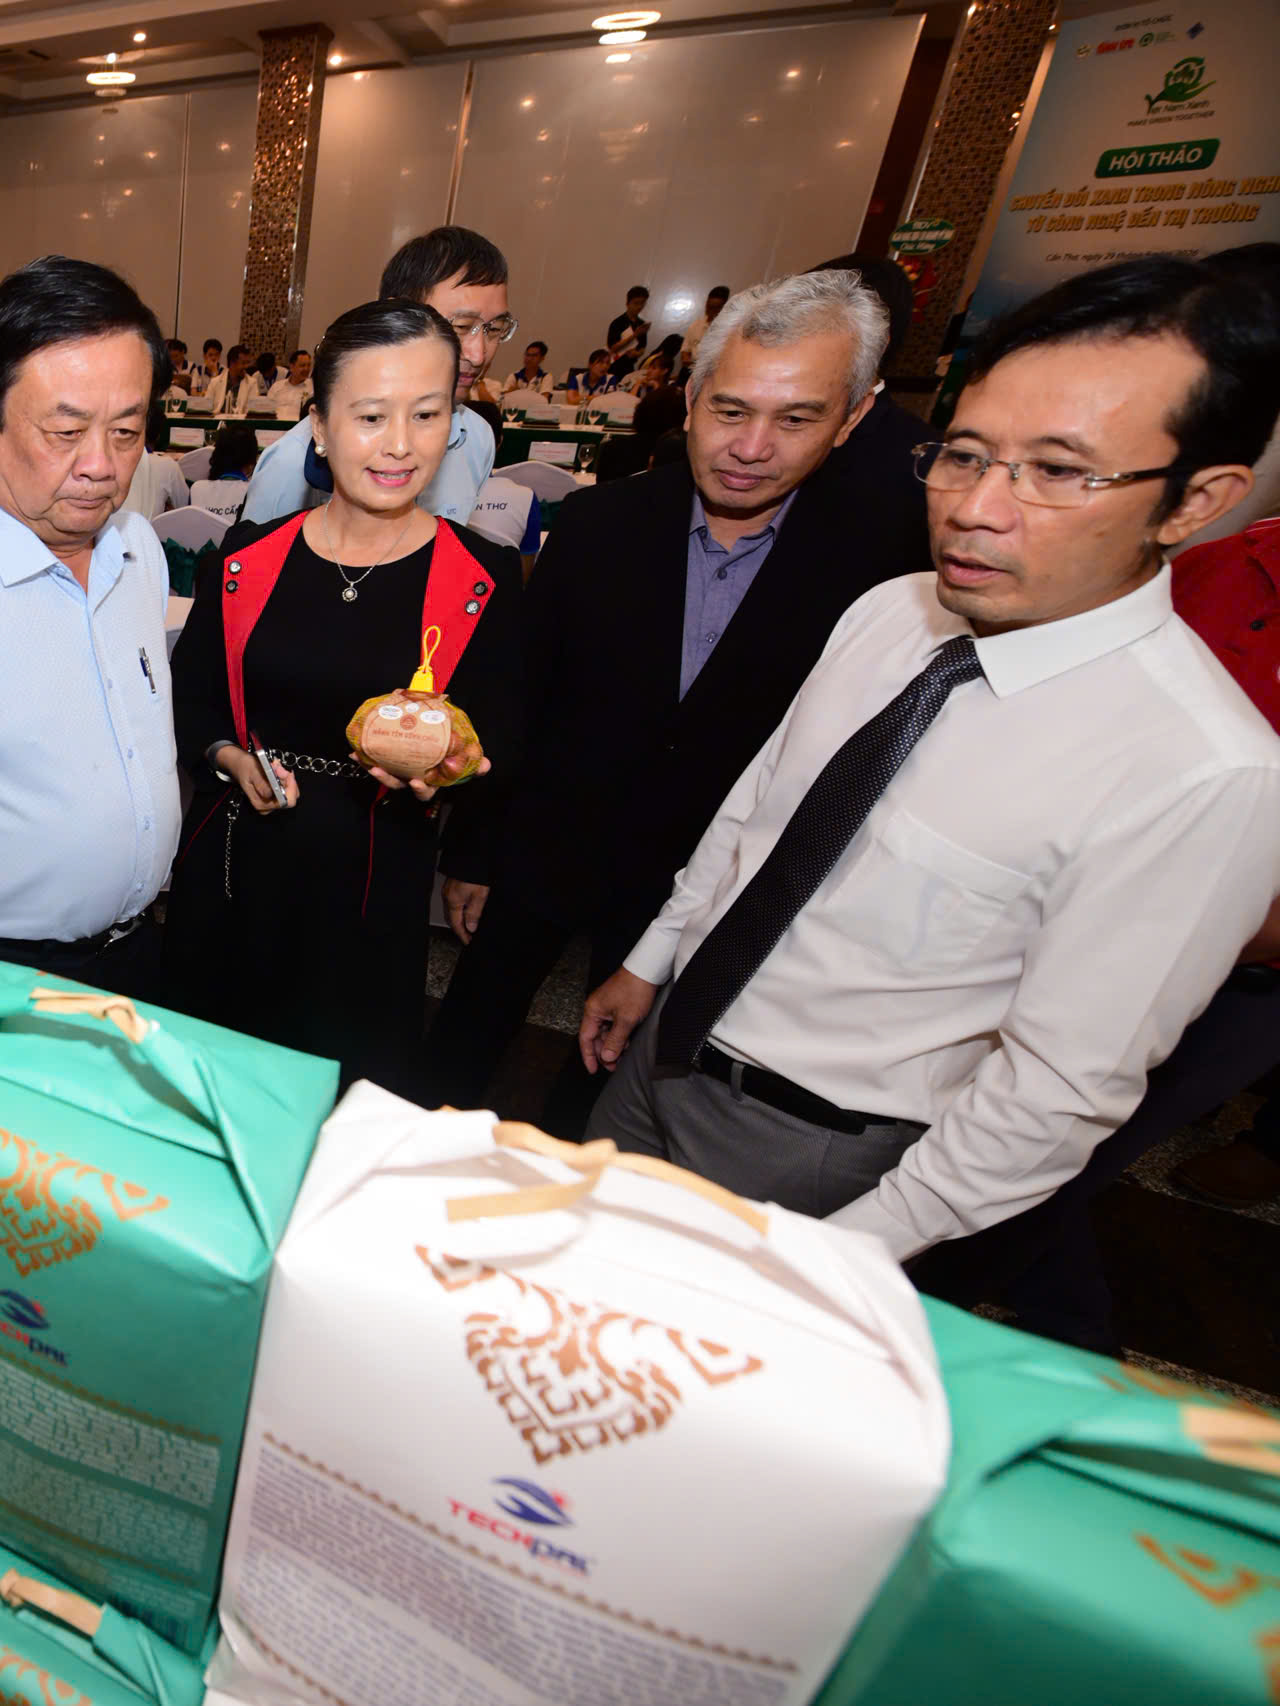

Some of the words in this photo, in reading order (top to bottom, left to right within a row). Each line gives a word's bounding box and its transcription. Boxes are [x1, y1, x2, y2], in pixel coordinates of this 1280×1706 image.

[1108, 151, 1144, 173] HỘI
[1148, 145, 1203, 167] THẢO
[1132, 183, 1187, 204] TRONG
[1186, 178, 1237, 200] NÔNG
[486, 502, 509, 511] THƠ
